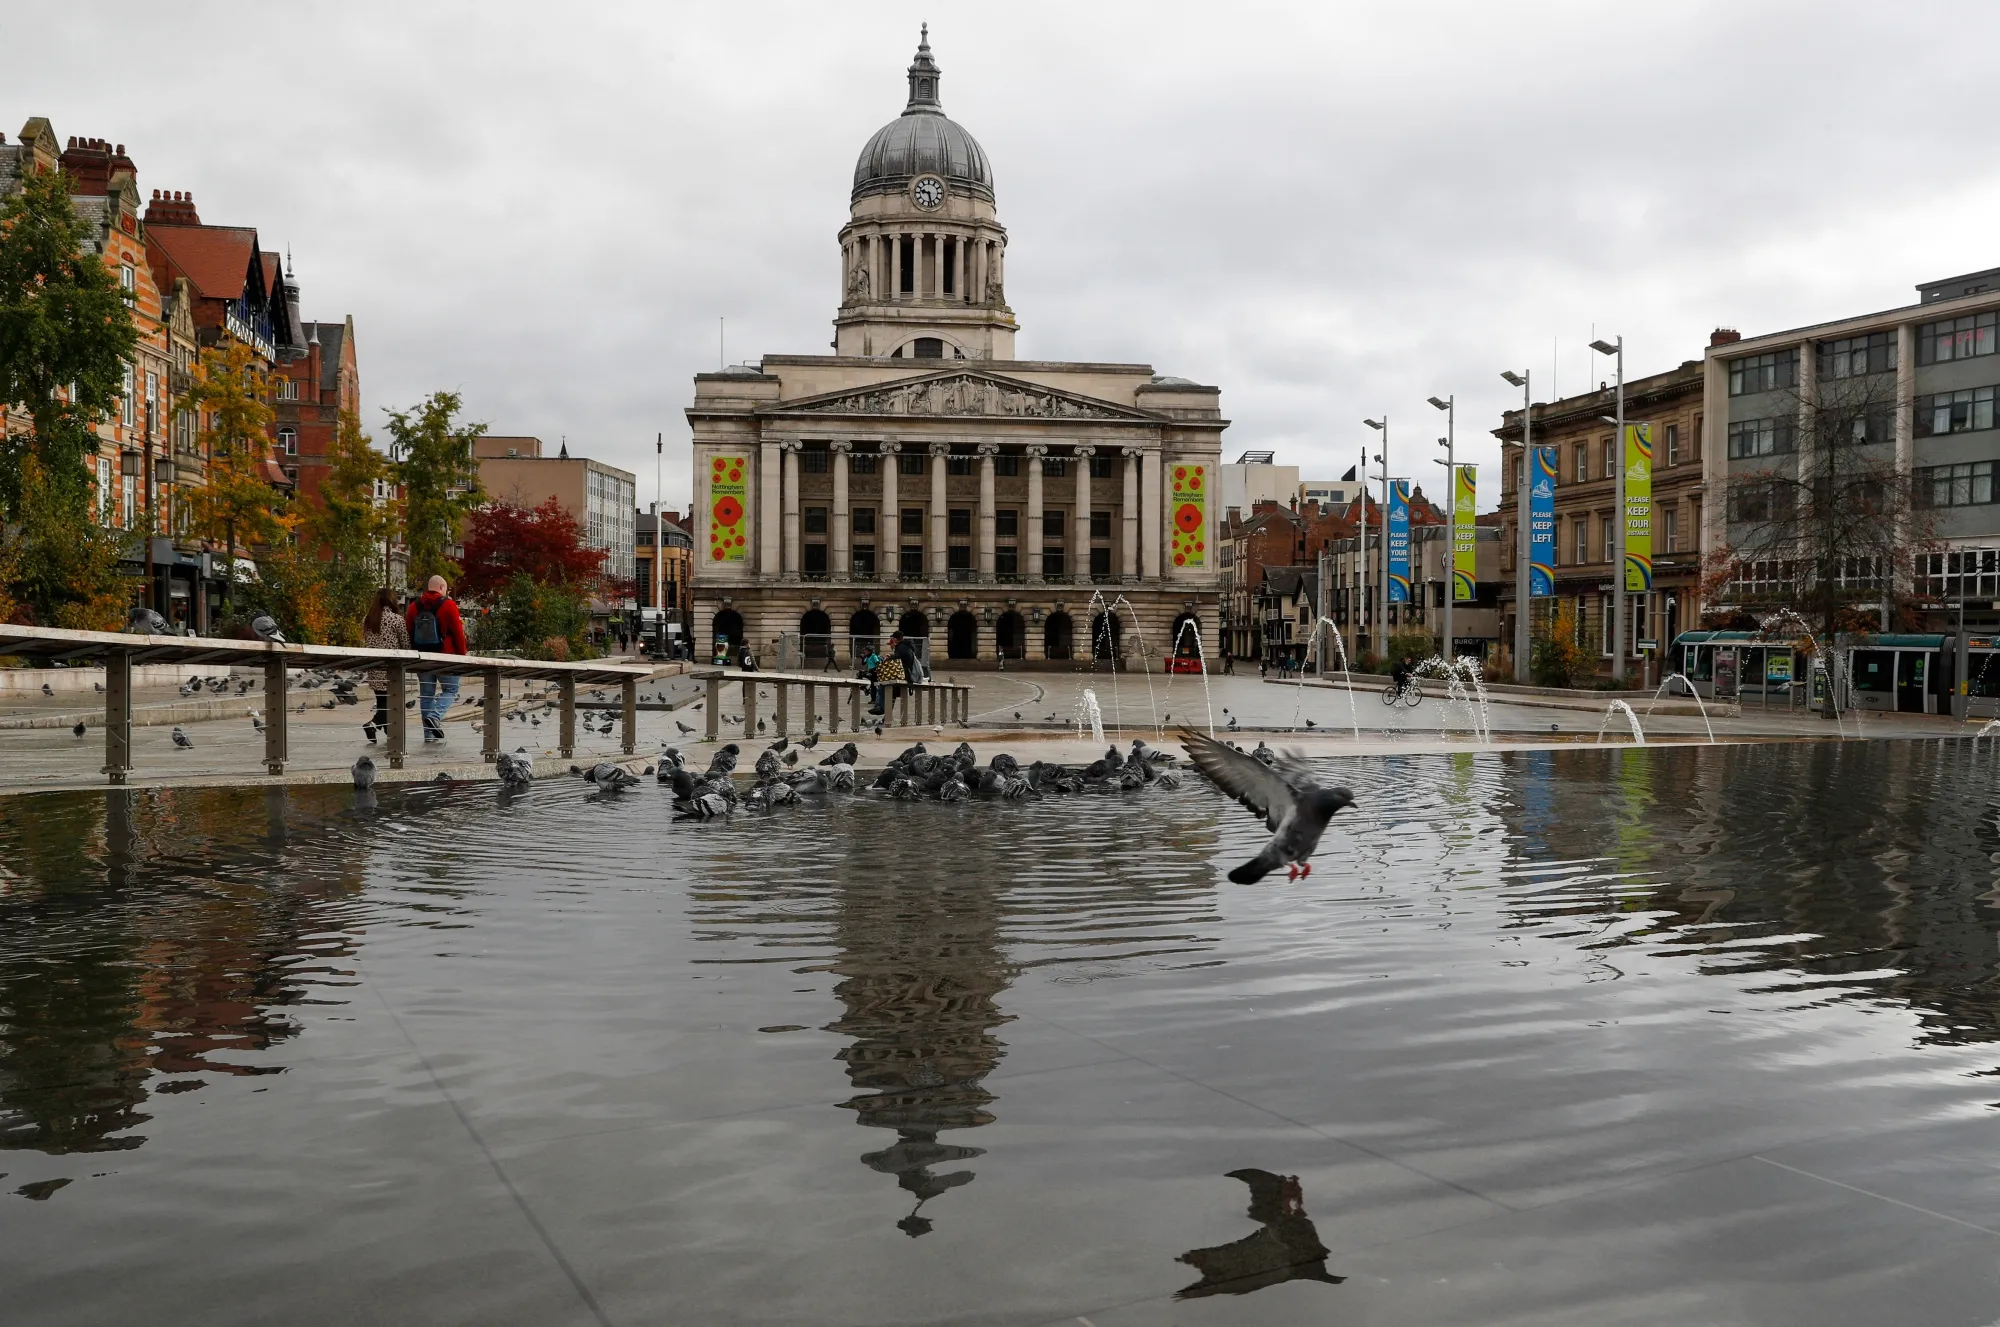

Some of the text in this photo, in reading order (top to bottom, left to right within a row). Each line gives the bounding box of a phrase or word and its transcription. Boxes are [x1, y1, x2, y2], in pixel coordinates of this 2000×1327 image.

[1627, 506, 1649, 516] KEEP
[1532, 521, 1553, 530] KEEP
[1627, 519, 1650, 529] YOUR
[1456, 532, 1475, 540] KEEP
[1532, 533, 1553, 543] LEFT
[1456, 543, 1475, 552] LEFT
[1390, 549, 1408, 557] YOUR
